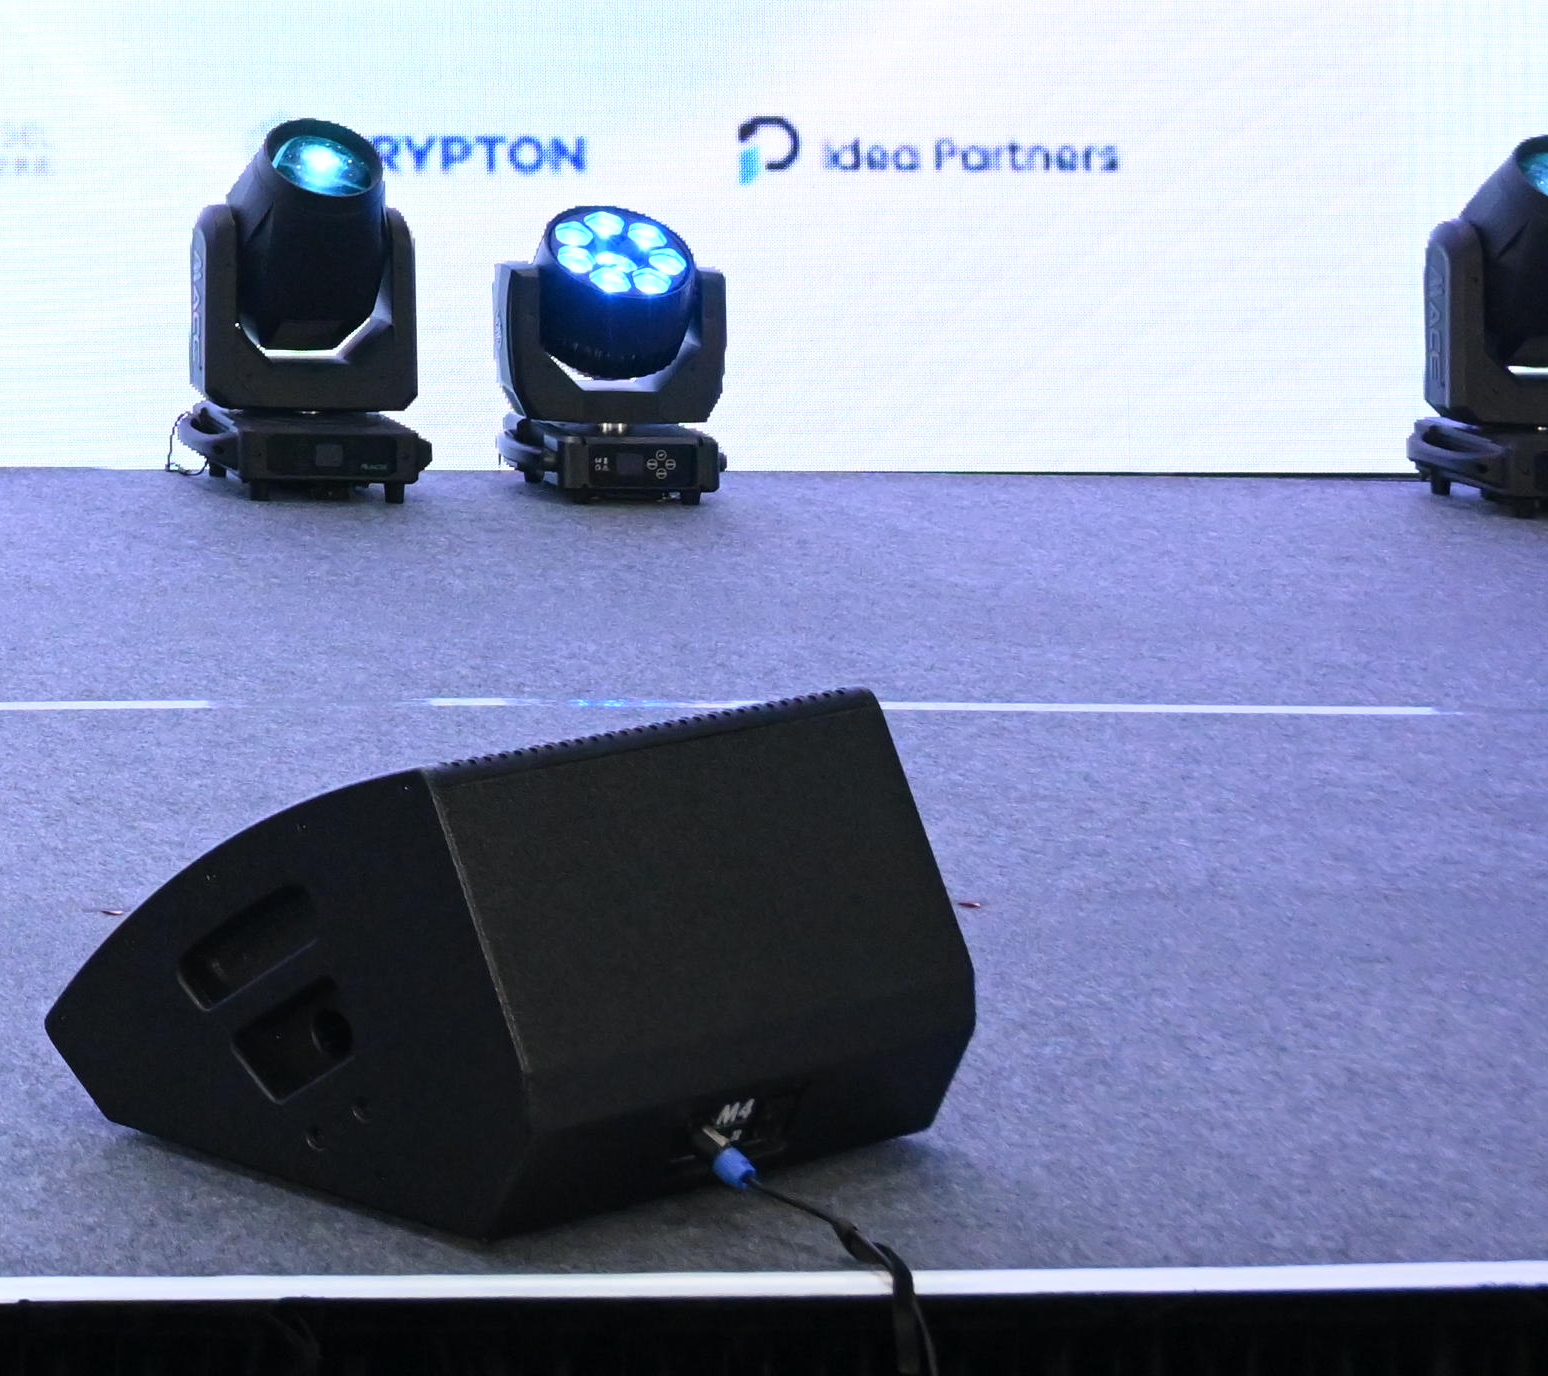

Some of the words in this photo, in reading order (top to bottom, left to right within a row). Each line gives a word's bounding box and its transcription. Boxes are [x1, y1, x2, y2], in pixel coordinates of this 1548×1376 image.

[369, 135, 587, 174] RYPTON
[933, 137, 1119, 173] Partners
[716, 1098, 755, 1126] M4
